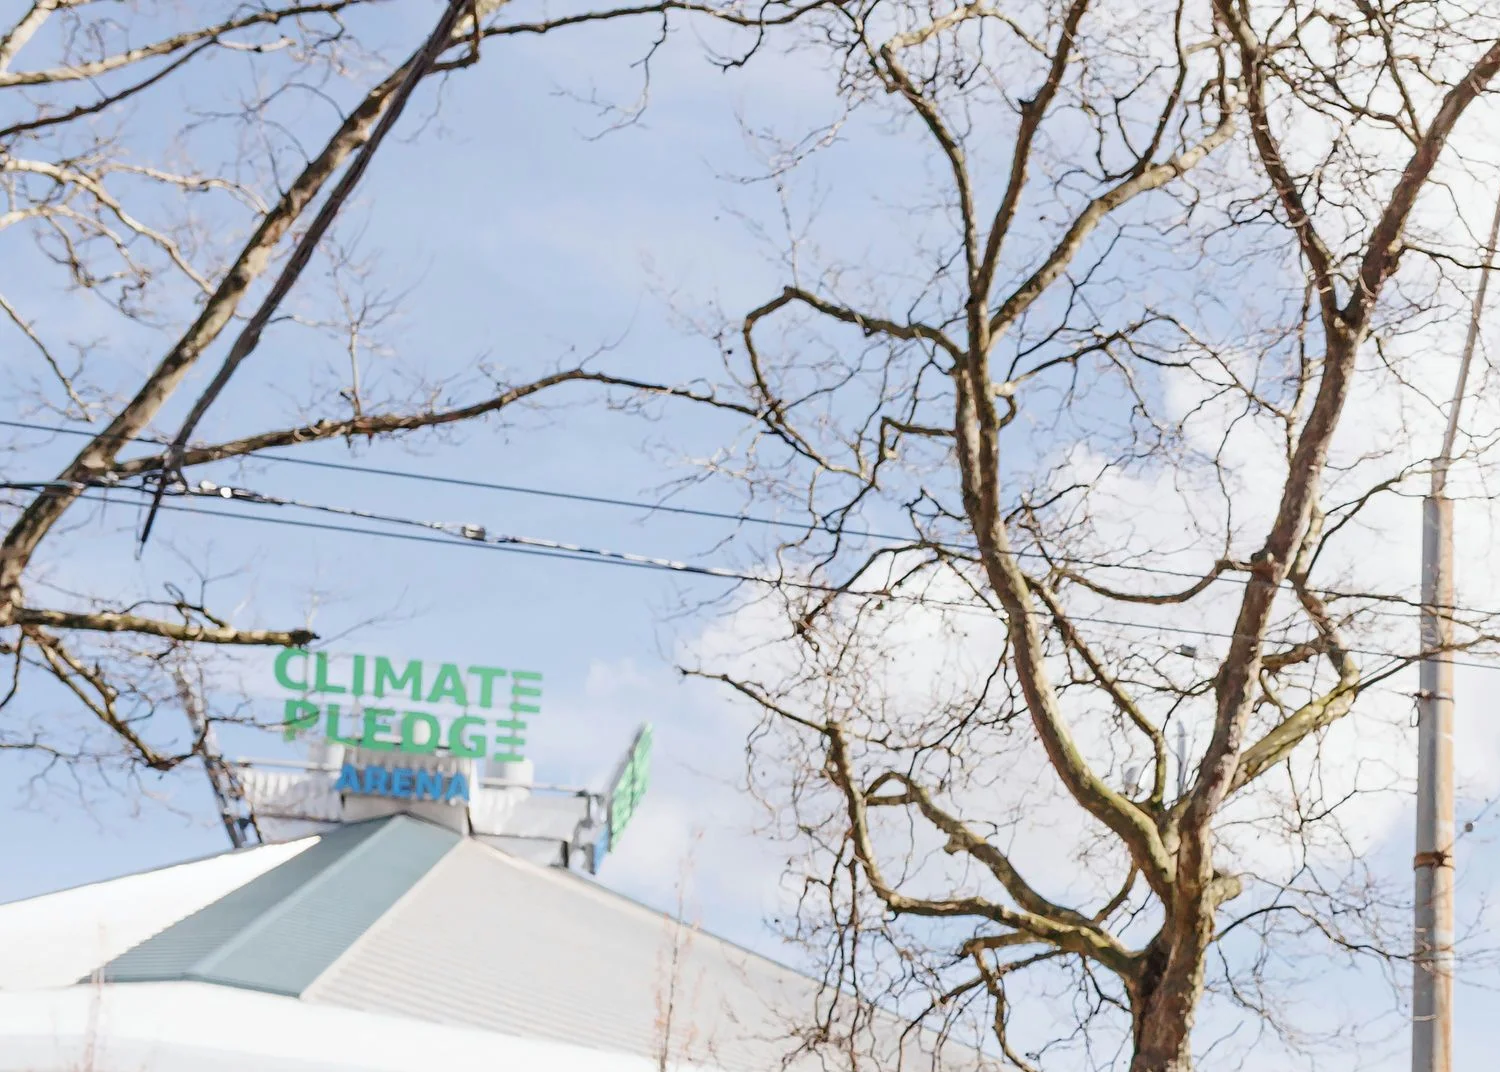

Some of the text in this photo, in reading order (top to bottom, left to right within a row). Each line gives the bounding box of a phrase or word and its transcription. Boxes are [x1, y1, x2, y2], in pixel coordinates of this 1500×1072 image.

[274, 647, 543, 713] CLIMATE
[283, 699, 527, 763] PLEDGE
[335, 763, 470, 801] ARENA
